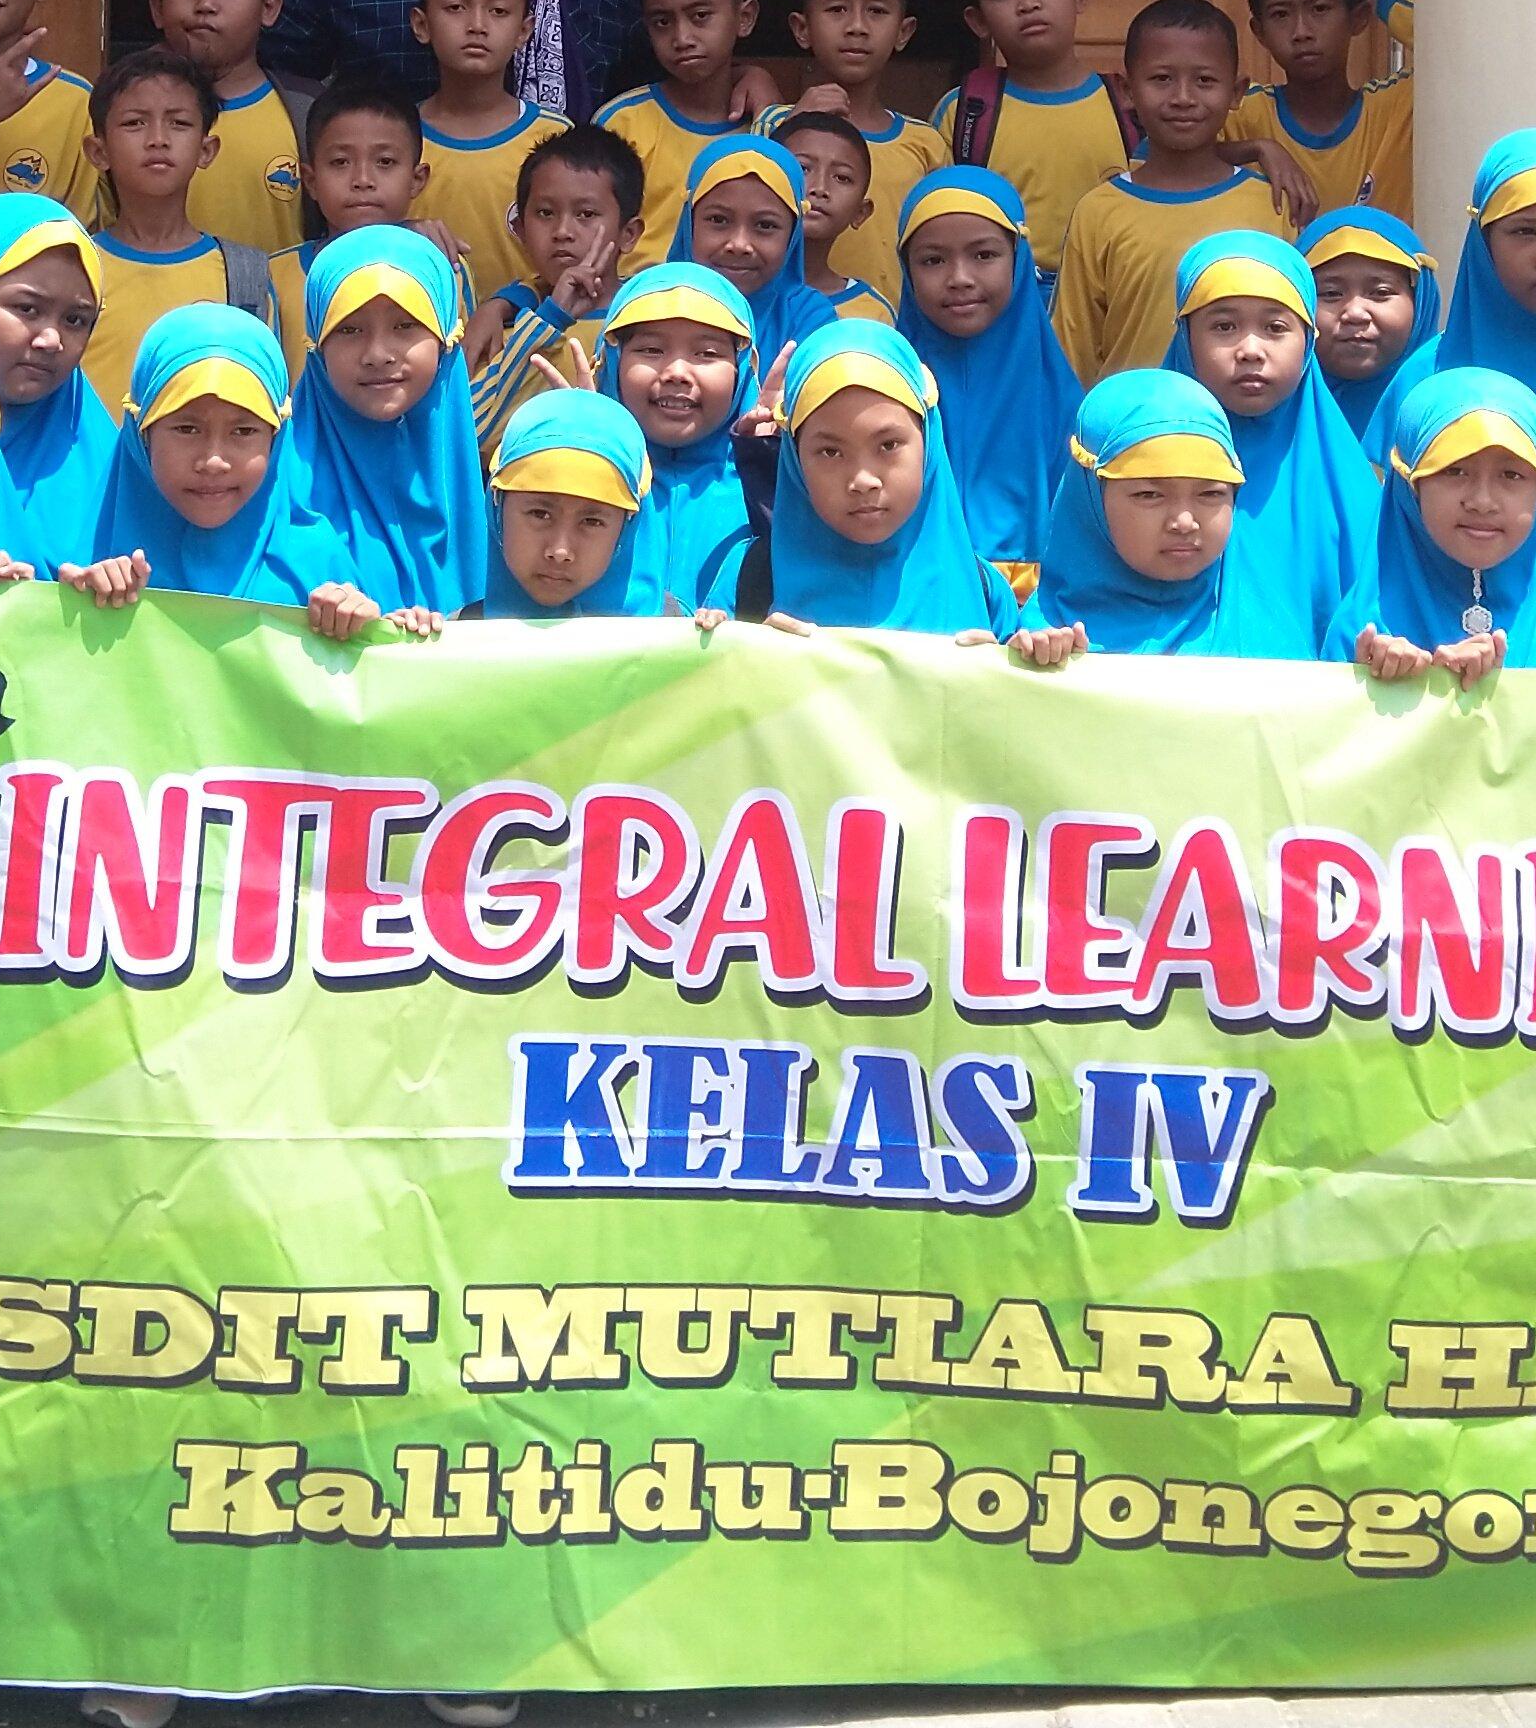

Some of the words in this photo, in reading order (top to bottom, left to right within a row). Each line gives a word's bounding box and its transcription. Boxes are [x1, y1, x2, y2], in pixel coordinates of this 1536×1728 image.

[501, 1032, 1036, 1217] KELAS
[1067, 1062, 1276, 1230] IV
[461, 1283, 1361, 1417] MUTIARA
